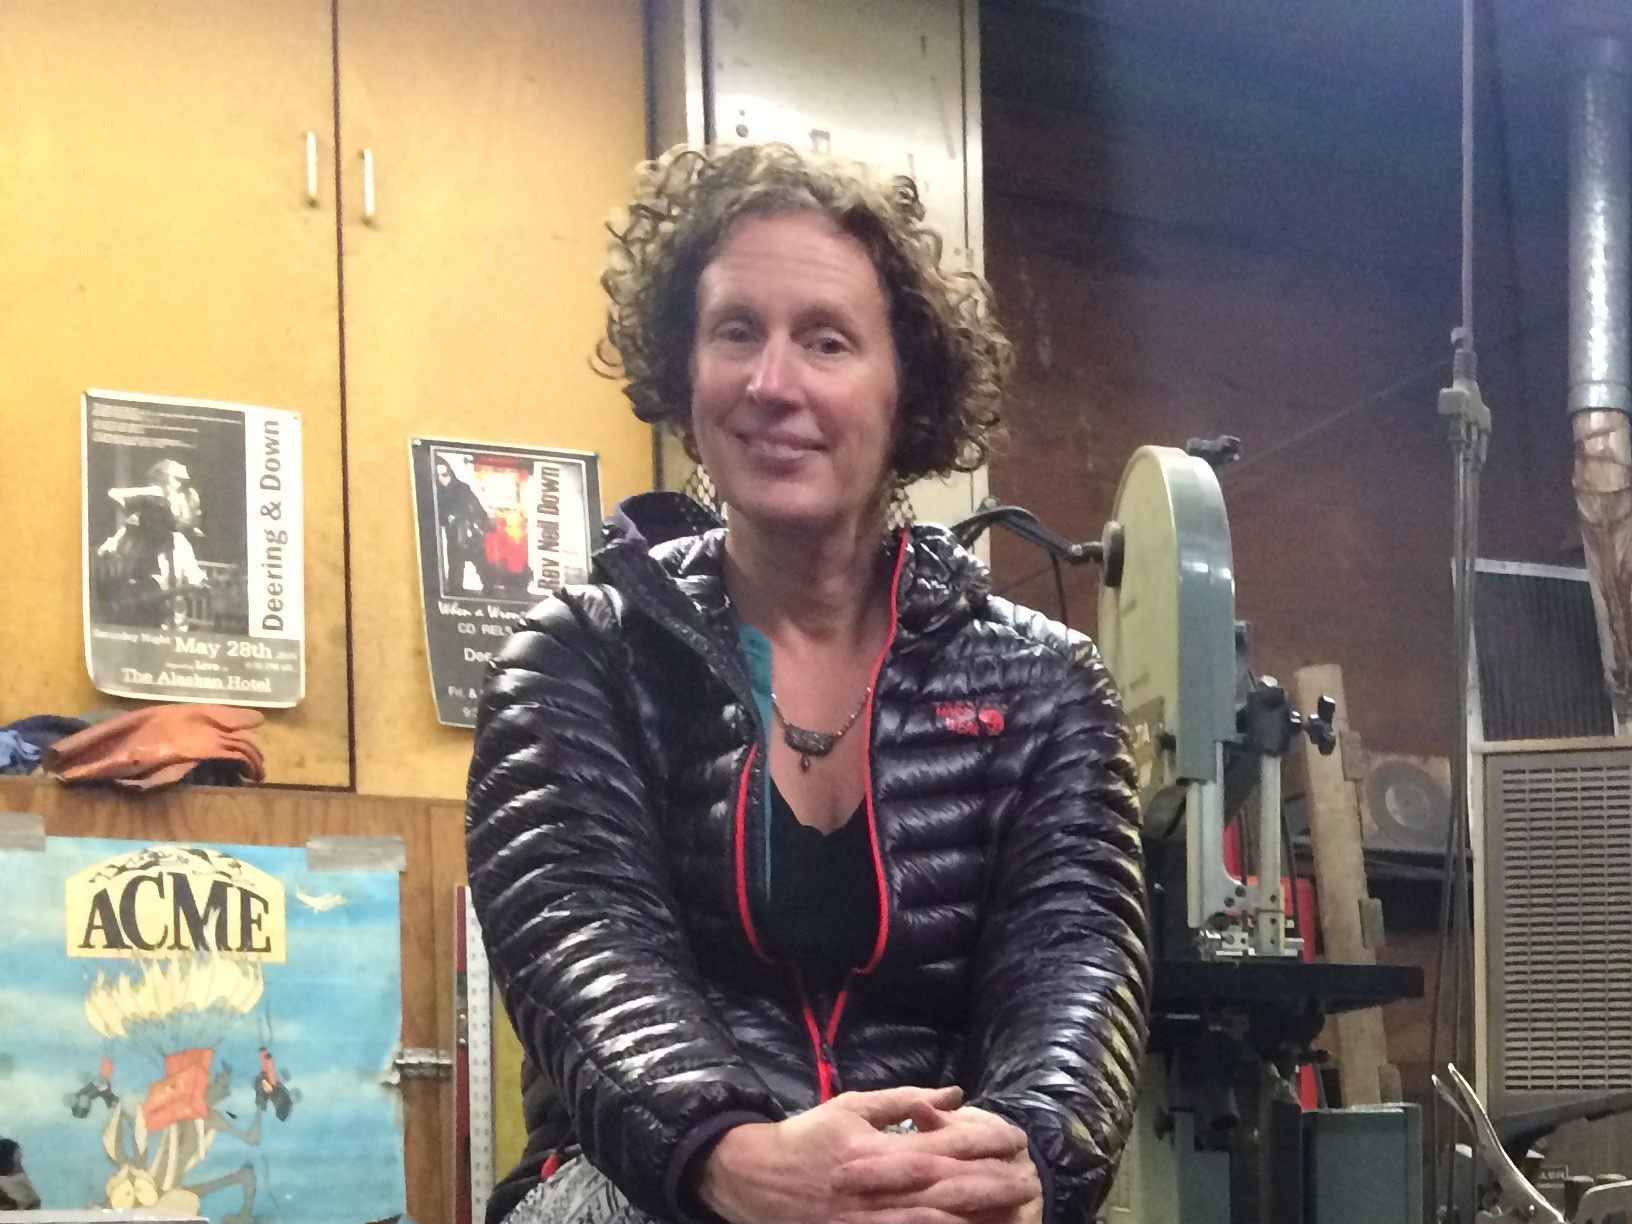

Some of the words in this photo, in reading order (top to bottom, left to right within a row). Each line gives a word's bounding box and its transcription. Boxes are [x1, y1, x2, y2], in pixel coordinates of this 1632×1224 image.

[259, 419, 282, 491] Down
[536, 465, 560, 516] Down
[259, 500, 282, 521] &
[261, 528, 289, 631] Deering
[537, 557, 560, 589] Rev
[437, 600, 473, 618] When
[457, 622, 477, 635] CD
[174, 636, 221, 659] May
[226, 639, 273, 660] 28th
[120, 666, 154, 684] The
[157, 671, 224, 690] Alaskan
[226, 675, 272, 693] Hotel
[77, 871, 272, 953] ACME
